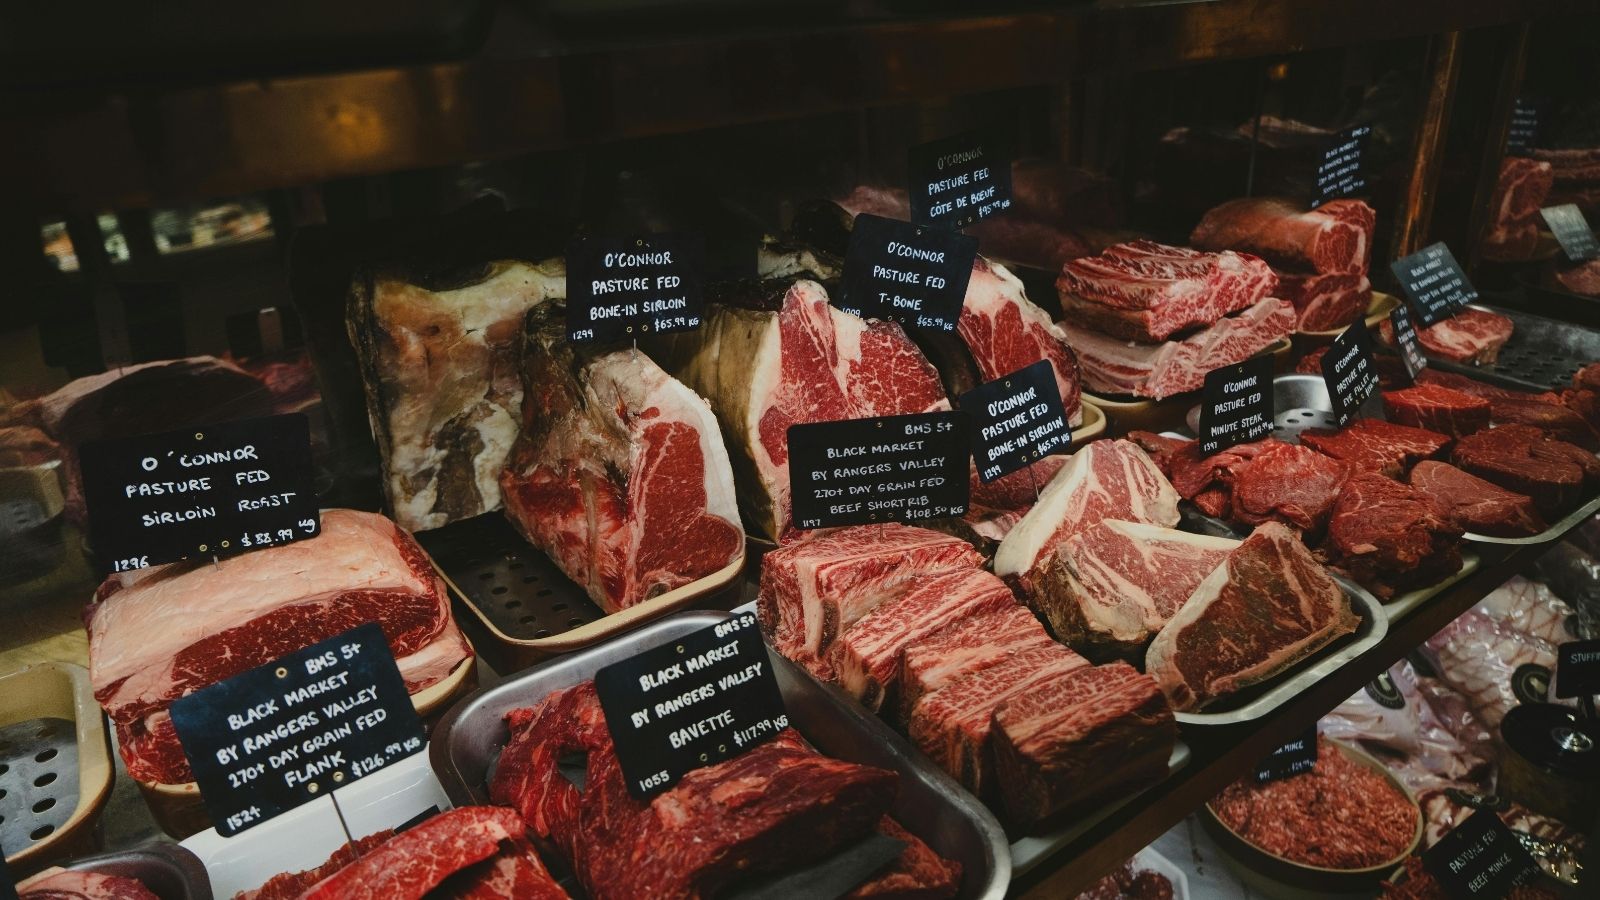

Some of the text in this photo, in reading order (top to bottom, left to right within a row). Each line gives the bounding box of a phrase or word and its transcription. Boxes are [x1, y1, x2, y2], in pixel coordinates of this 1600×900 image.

[938, 146, 983, 170] O'CONNOR
[928, 168, 990, 196] PASTURE FED
[956, 197, 968, 208] DE
[605, 252, 673, 268] O'CONNOR
[887, 242, 945, 264] O'CONNOR
[592, 276, 680, 296] PASTURE FED
[873, 265, 946, 289] PASTURE FED
[590, 296, 686, 320] BONE-IN SIRLOIN
[573, 329, 594, 340] 1299
[654, 317, 699, 332] $65.99 KG
[917, 315, 954, 331] $65.99 KG
[1335, 344, 1360, 373] O'CONNOR
[1224, 376, 1257, 393] O'CONNOR
[1337, 358, 1367, 395] PASTURE FED
[988, 387, 1037, 417] O'CONNOR
[1343, 393, 1353, 407] EYE
[1354, 373, 1370, 396] FILLET
[1215, 393, 1261, 415] PASTURE FED
[905, 422, 953, 435] BMS 5+
[982, 403, 1049, 441] PASTURE FED
[1211, 413, 1263, 437] MINUTE STEAK
[827, 441, 925, 459] BLACK MARKET
[988, 416, 1064, 461] BONE-IN SIRLOIN
[1038, 433, 1070, 456] $65.99 KG
[812, 457, 945, 481] BY RANGERS VALLEY
[984, 465, 1002, 480] 1299
[126, 470, 270, 499] PASTURE FED
[814, 477, 945, 499] 270+ DAY GRAIN FED
[830, 502, 862, 515] BEEF
[906, 506, 964, 520] $108.50 KG
[803, 519, 821, 528] 1197
[115, 556, 150, 572] 1296
[714, 615, 755, 638] BMS 5+
[304, 642, 362, 676] BMS 5+
[639, 640, 739, 693] BLACK MARKET
[227, 671, 350, 731] BLACK MARKET
[631, 662, 762, 729] BY RANGERS VALLEY
[216, 685, 378, 766] BY RANGERS VALLEY
[669, 710, 736, 750] BAVETTE
[733, 715, 789, 747] $117.99 KG
[228, 708, 388, 789] 270+ DAY GRAIN FED
[351, 737, 421, 779] $126.99 KG
[1285, 740, 1304, 752] MINCE
[284, 751, 346, 788] FLANK
[639, 770, 670, 792] 1055
[226, 805, 261, 831] 1524
[1449, 841, 1484, 875] PASTURE
[1468, 872, 1488, 893] BEEF
[1488, 853, 1513, 876] MINCE
